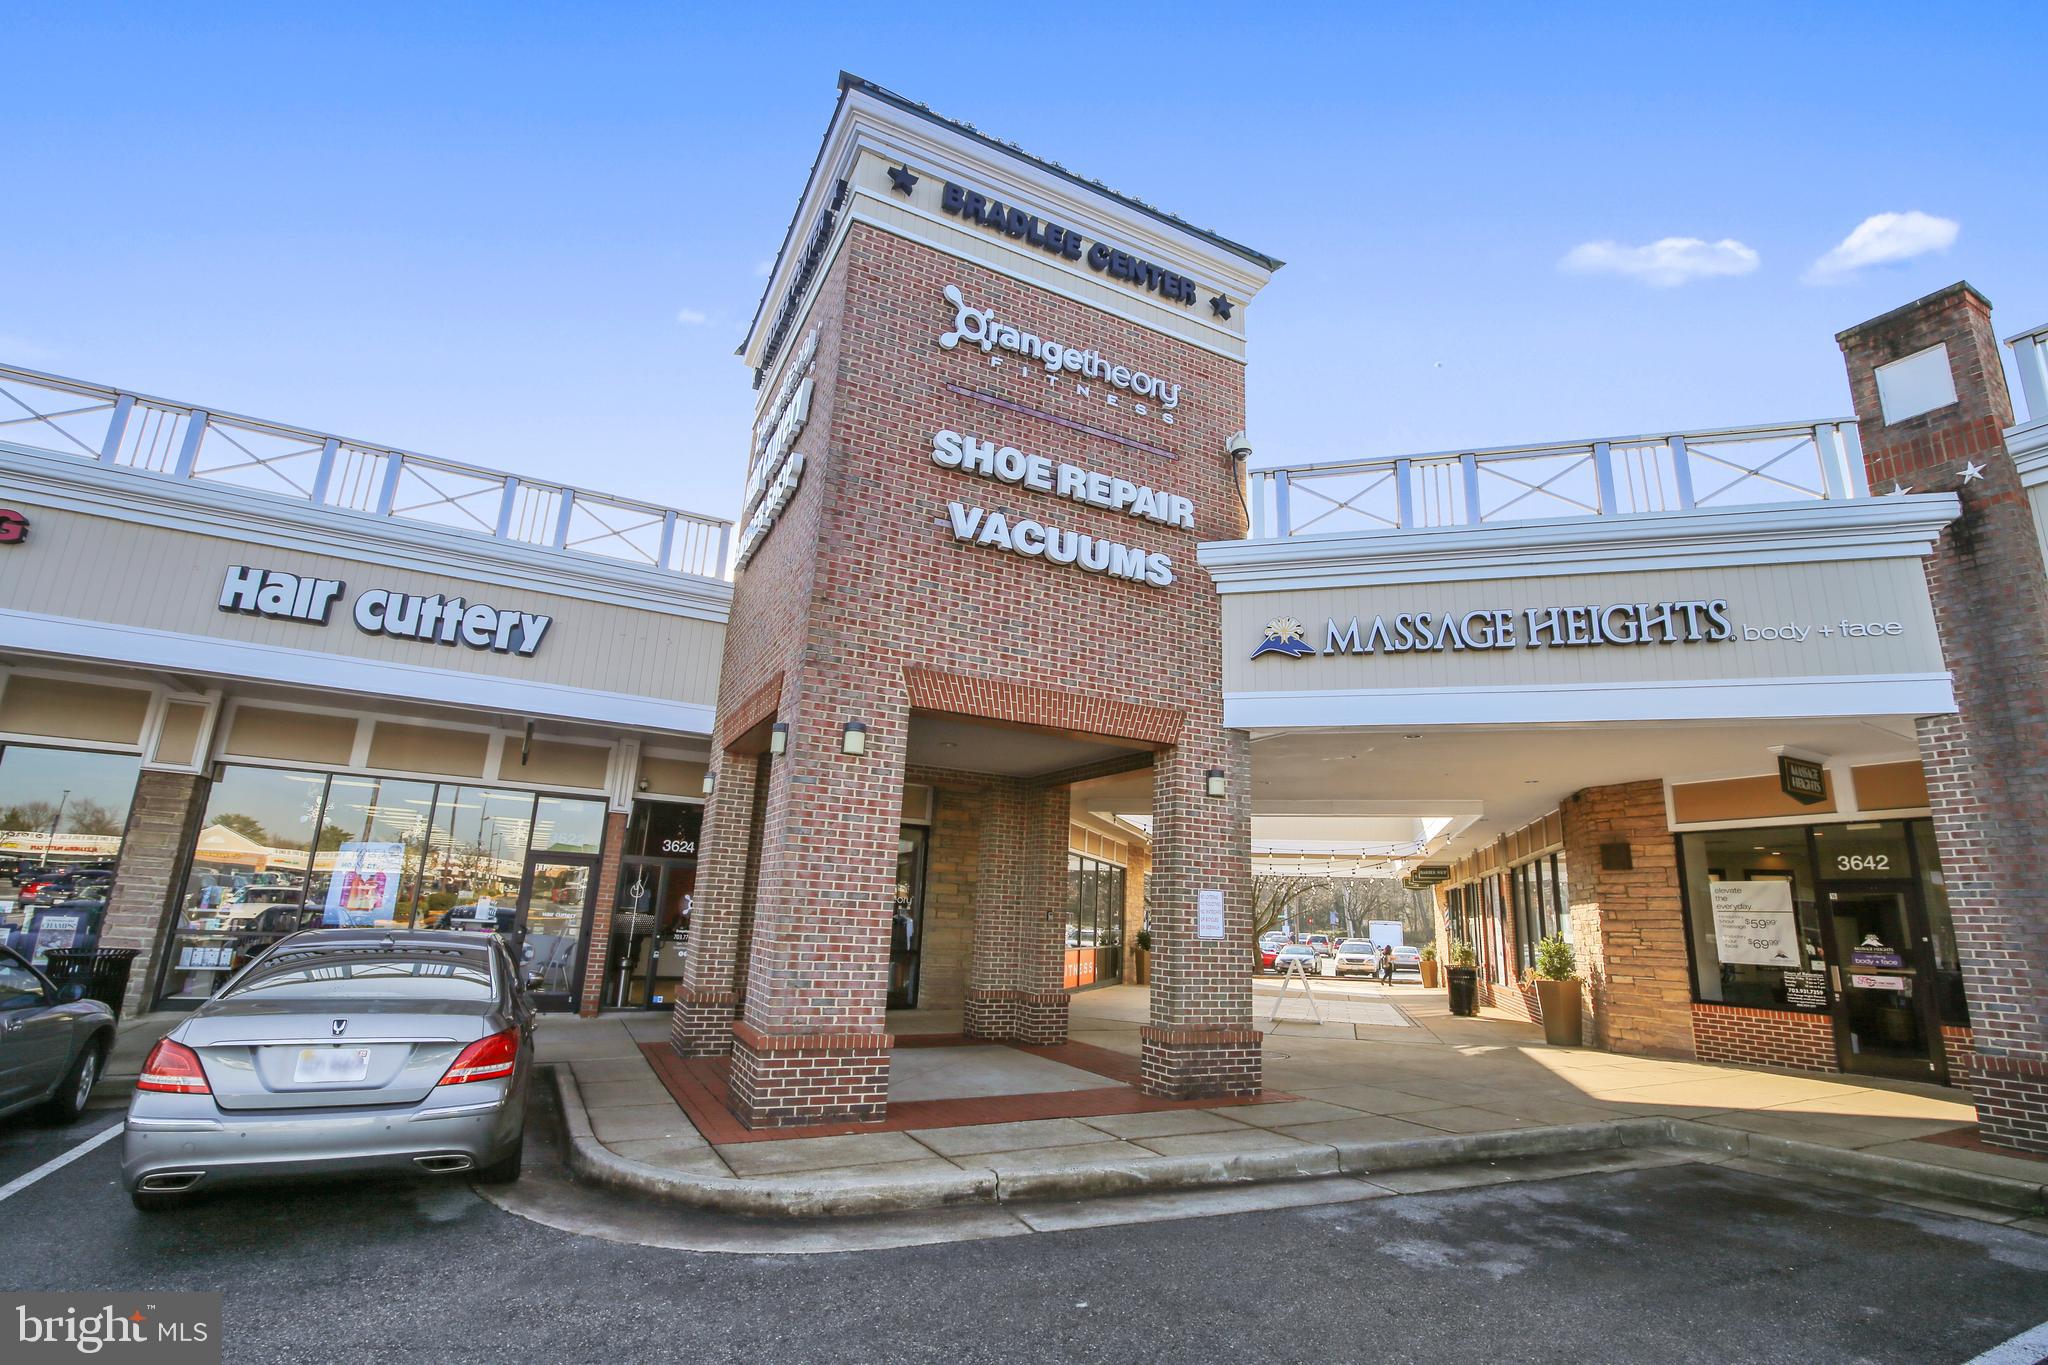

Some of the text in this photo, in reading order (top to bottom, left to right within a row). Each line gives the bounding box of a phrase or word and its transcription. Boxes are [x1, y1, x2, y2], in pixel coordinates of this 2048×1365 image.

[941, 181, 1197, 306] BRADLEE CENTER
[990, 356, 1174, 425] FITNESS
[932, 429, 1195, 529] SHOE REPAIR
[948, 501, 1173, 588] VACUUMS
[219, 565, 553, 658] Hair cuttery
[1323, 599, 1904, 656] MASSAGE HEIGHTS body + face
[662, 839, 695, 853] 3624
[1837, 854, 1890, 871] 3642
[1716, 903, 1752, 911] everyday
